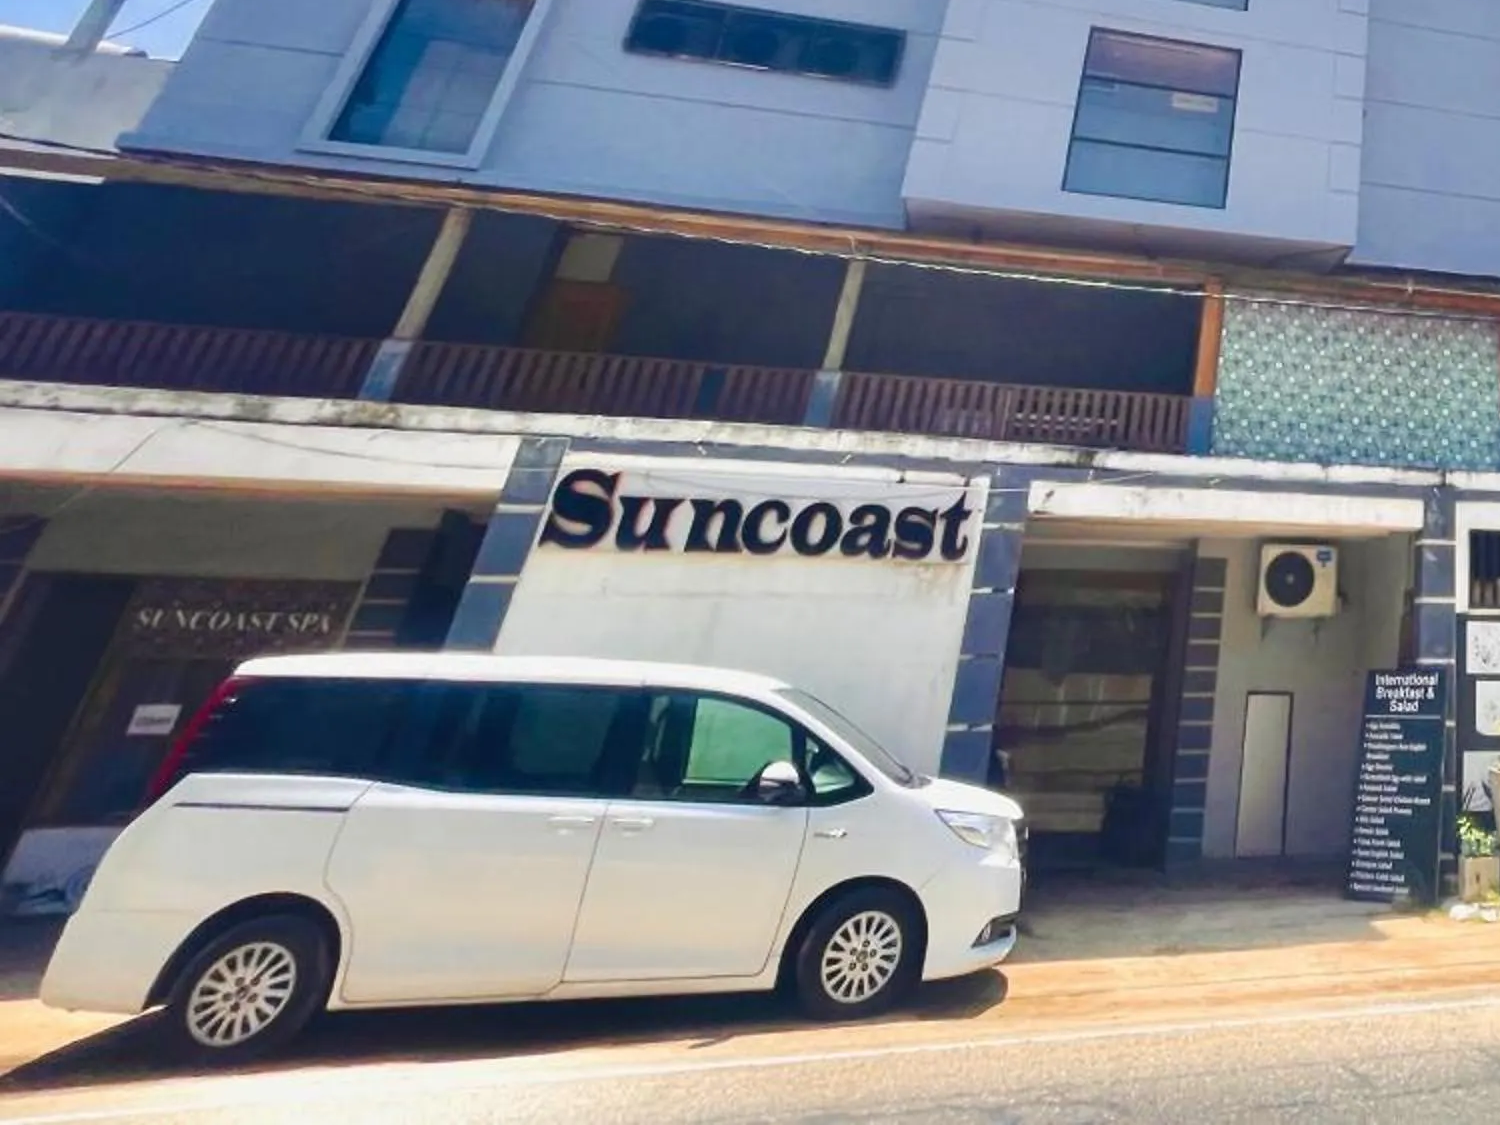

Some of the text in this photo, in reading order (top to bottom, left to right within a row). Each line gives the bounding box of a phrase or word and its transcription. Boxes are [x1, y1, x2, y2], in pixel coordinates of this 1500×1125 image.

[538, 468, 972, 561] Suncoast
[137, 608, 330, 634] SUNCOAST SPA
[1375, 672, 1439, 686] International
[1376, 686, 1435, 700] Breakfast &
[1389, 700, 1419, 712] Salad
